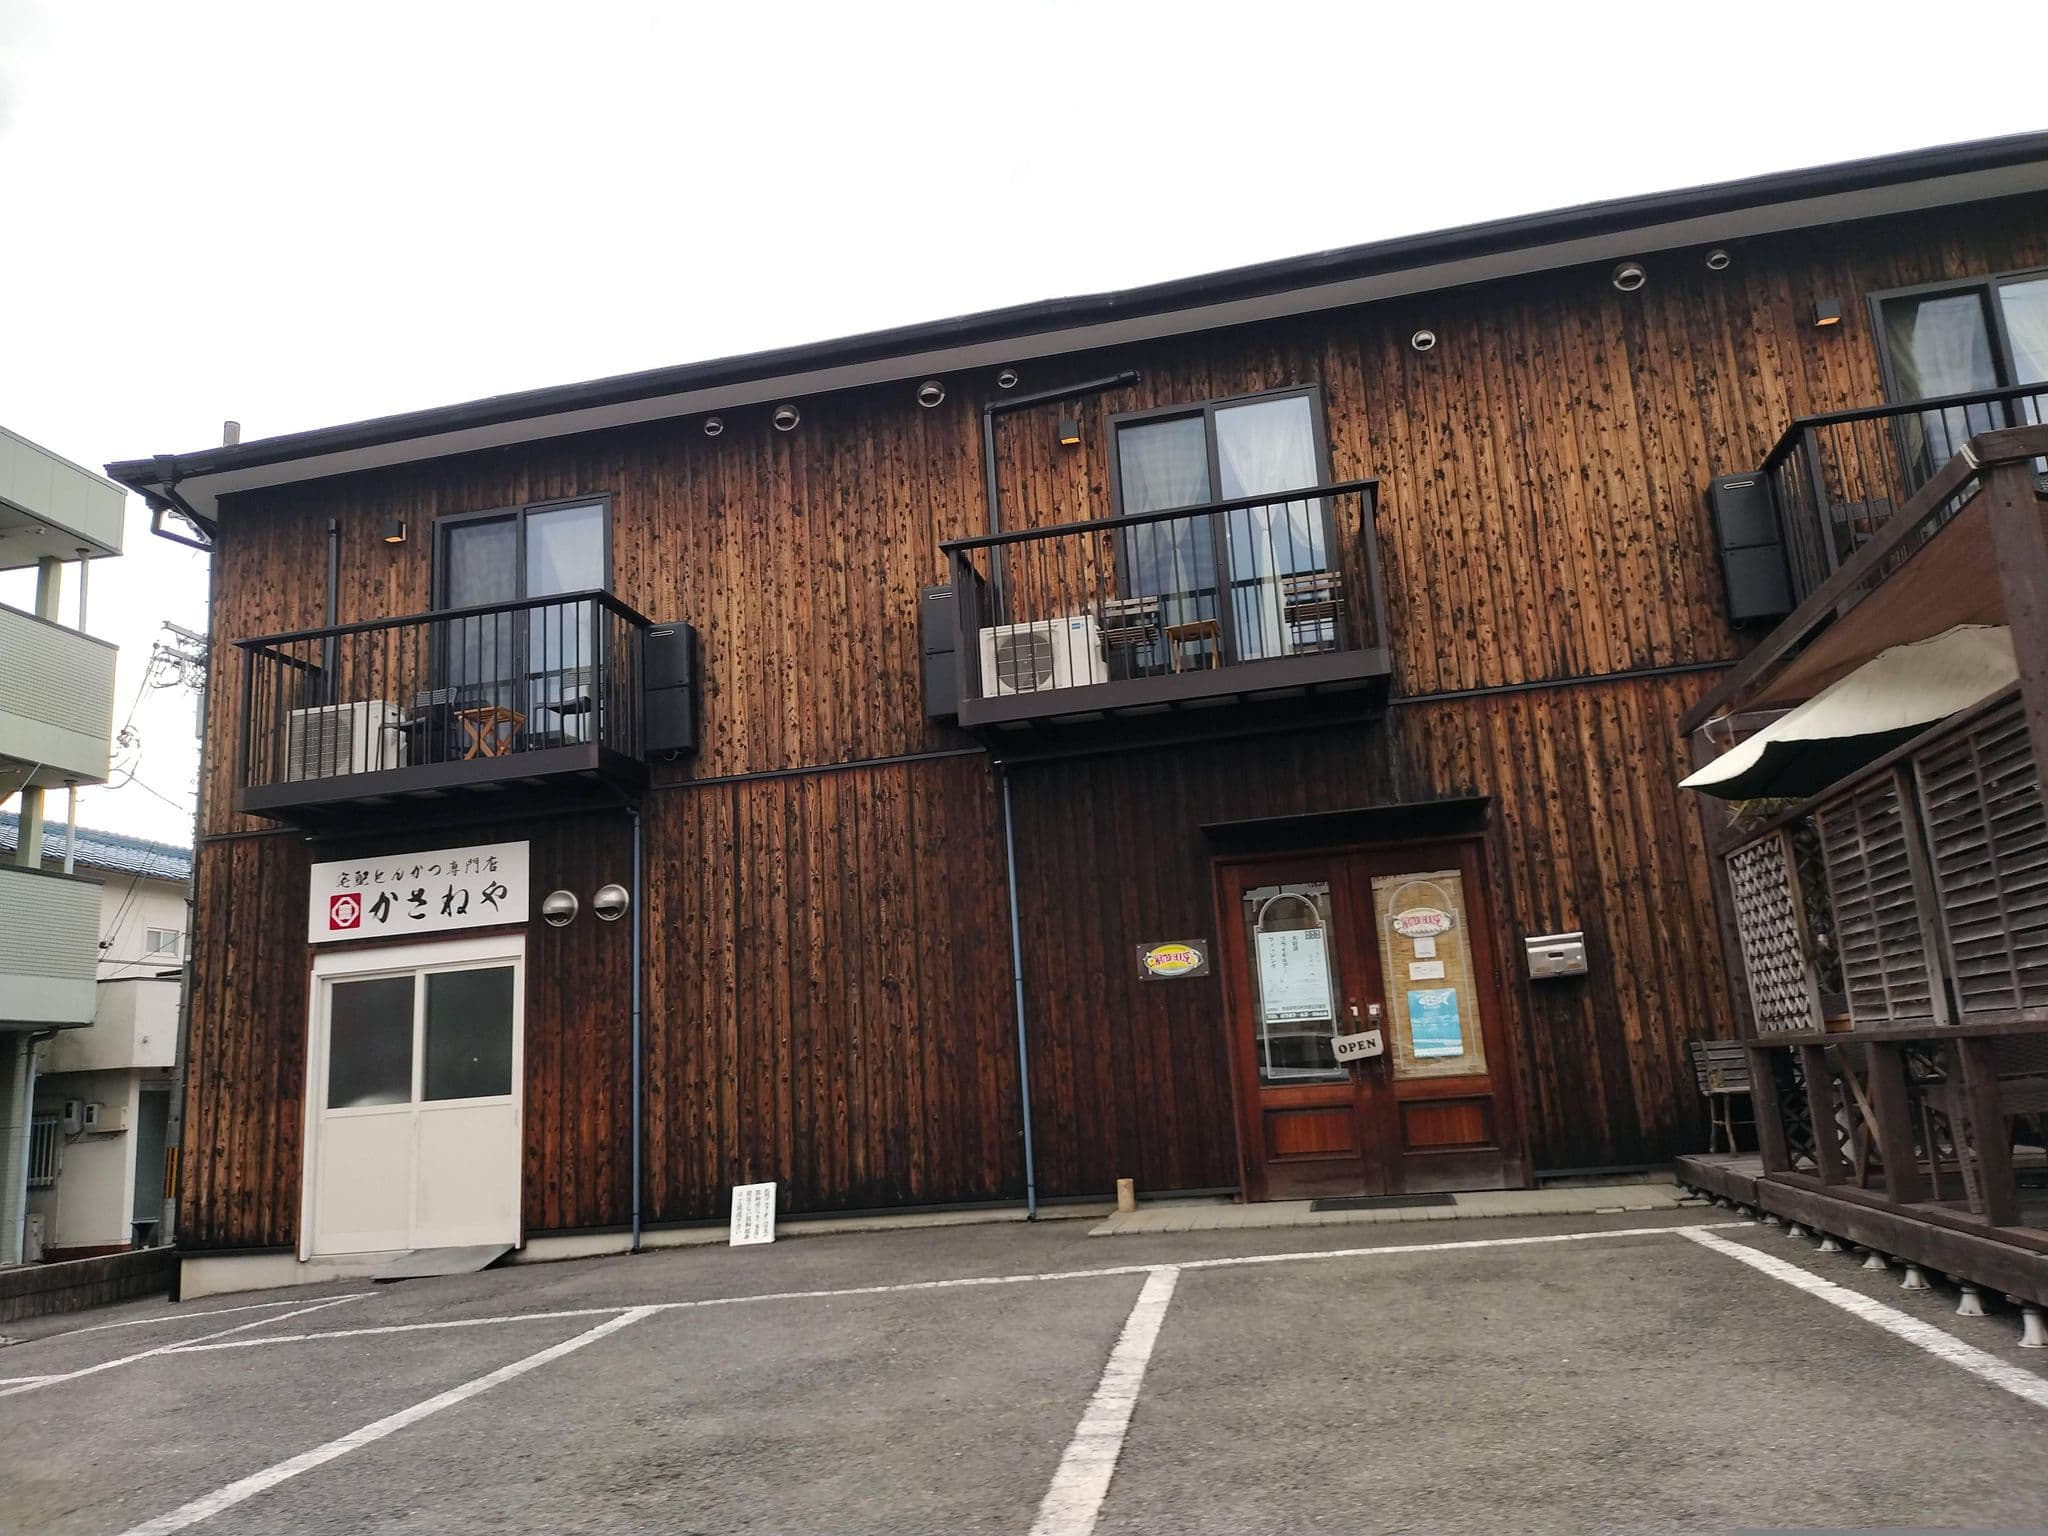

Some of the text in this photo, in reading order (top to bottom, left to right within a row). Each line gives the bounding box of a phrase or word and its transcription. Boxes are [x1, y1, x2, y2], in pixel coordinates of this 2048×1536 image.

[336, 855, 499, 888] 宅配とんかつ専門店
[368, 880, 508, 923] かさねや
[1338, 1038, 1376, 1054] OPEN
